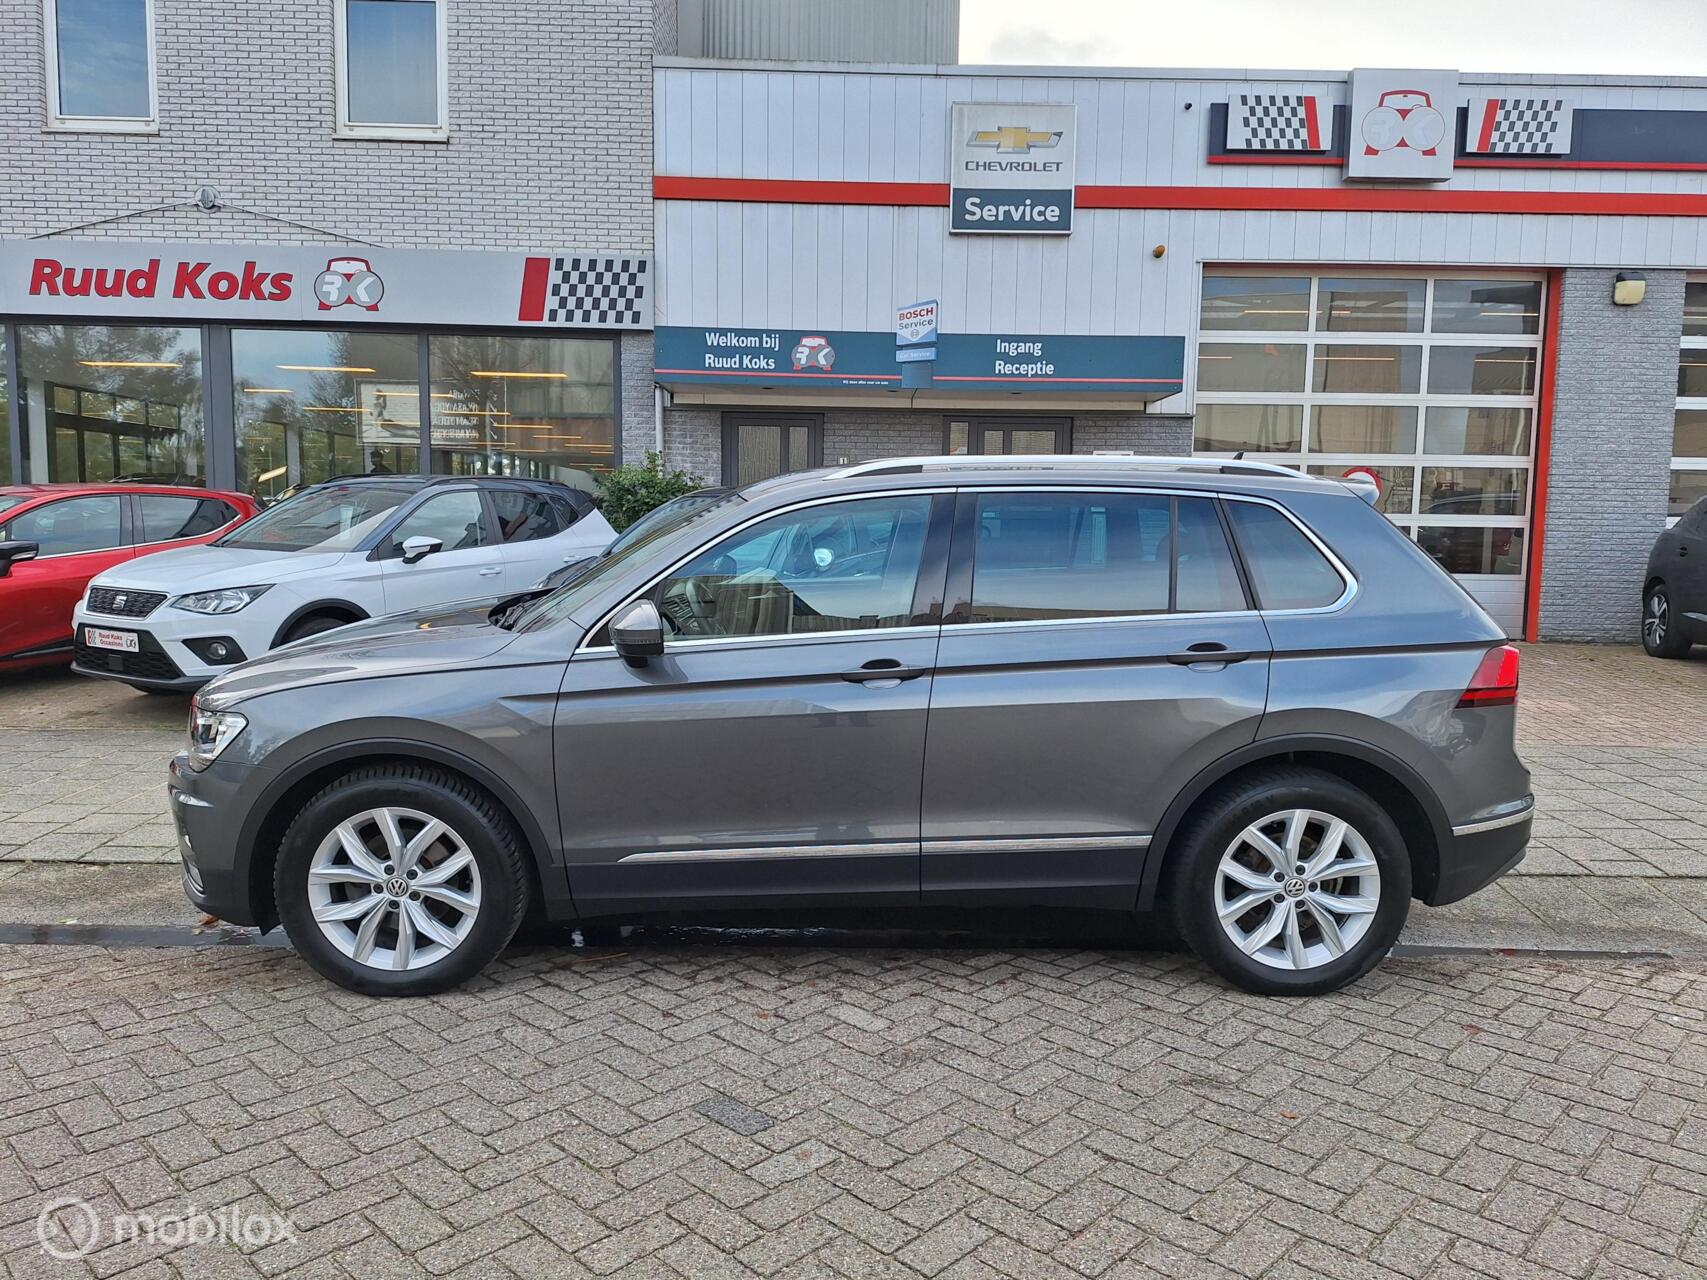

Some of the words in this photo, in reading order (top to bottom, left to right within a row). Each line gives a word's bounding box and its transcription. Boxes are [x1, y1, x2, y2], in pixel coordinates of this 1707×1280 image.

[964, 160, 1064, 173] CHEVROLET
[964, 196, 1060, 222] Service
[29, 258, 161, 298] Ruud
[172, 261, 294, 301] Koks
[898, 307, 934, 322] BOSCH
[898, 318, 934, 331] Service
[705, 331, 760, 348] Welkom
[762, 333, 780, 351] bij
[996, 339, 1043, 356] Ingang
[704, 353, 740, 368] Ruud
[742, 354, 776, 369] Koks
[995, 360, 1055, 377] Receptie
